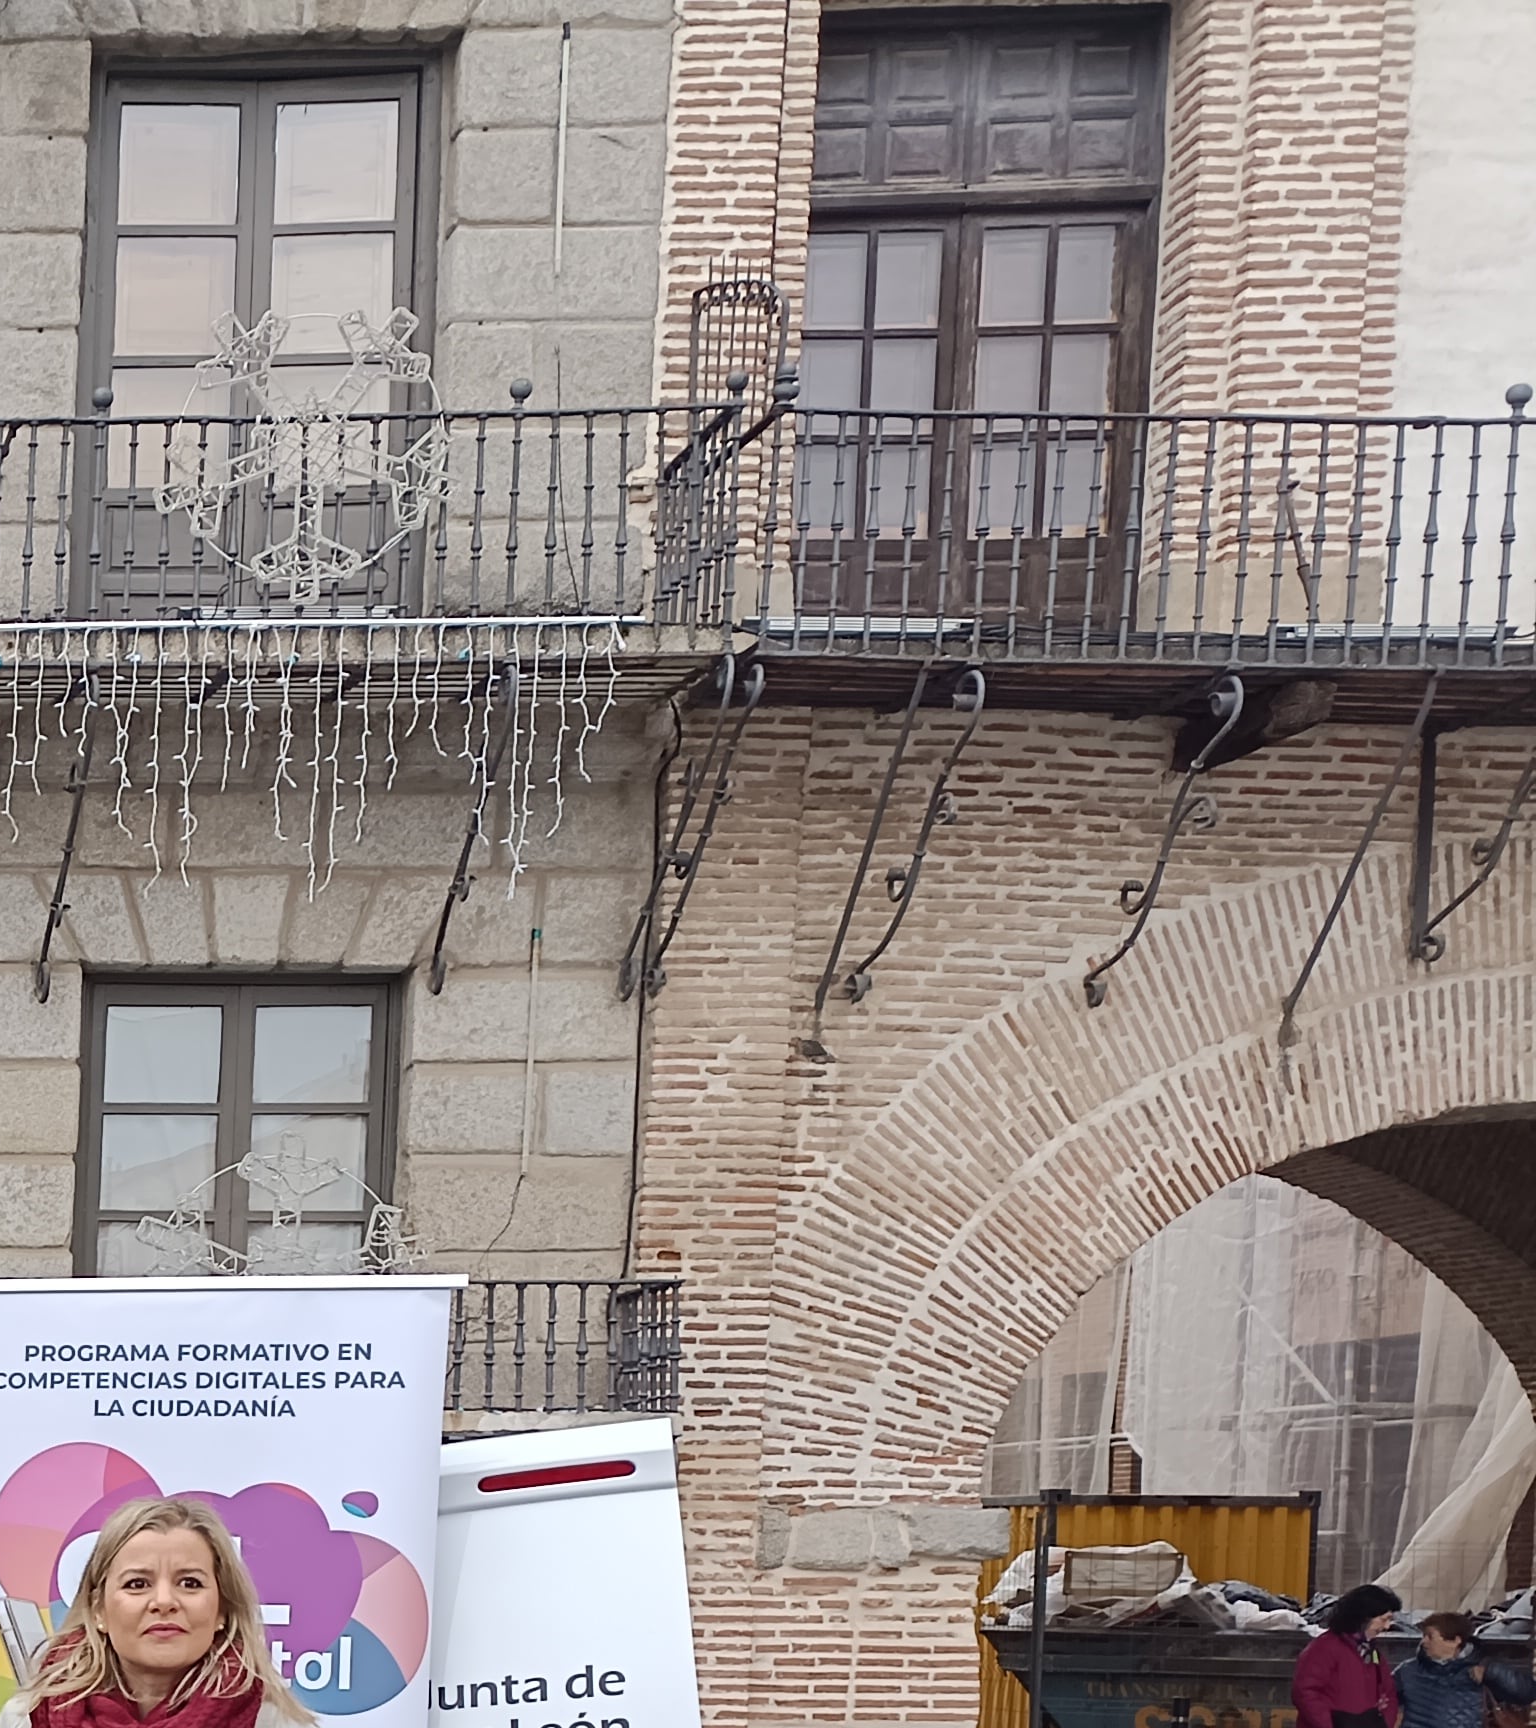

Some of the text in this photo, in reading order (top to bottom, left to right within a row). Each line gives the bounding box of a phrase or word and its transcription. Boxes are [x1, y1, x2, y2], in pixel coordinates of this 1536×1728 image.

[24, 1342, 372, 1362] PROGRAMA FORMATIVO EN
[195, 1371, 327, 1389] DIGITALES
[334, 1370, 406, 1389] PARA
[93, 1395, 296, 1417] LA CIUDADANÍA
[565, 1665, 626, 1699] de
